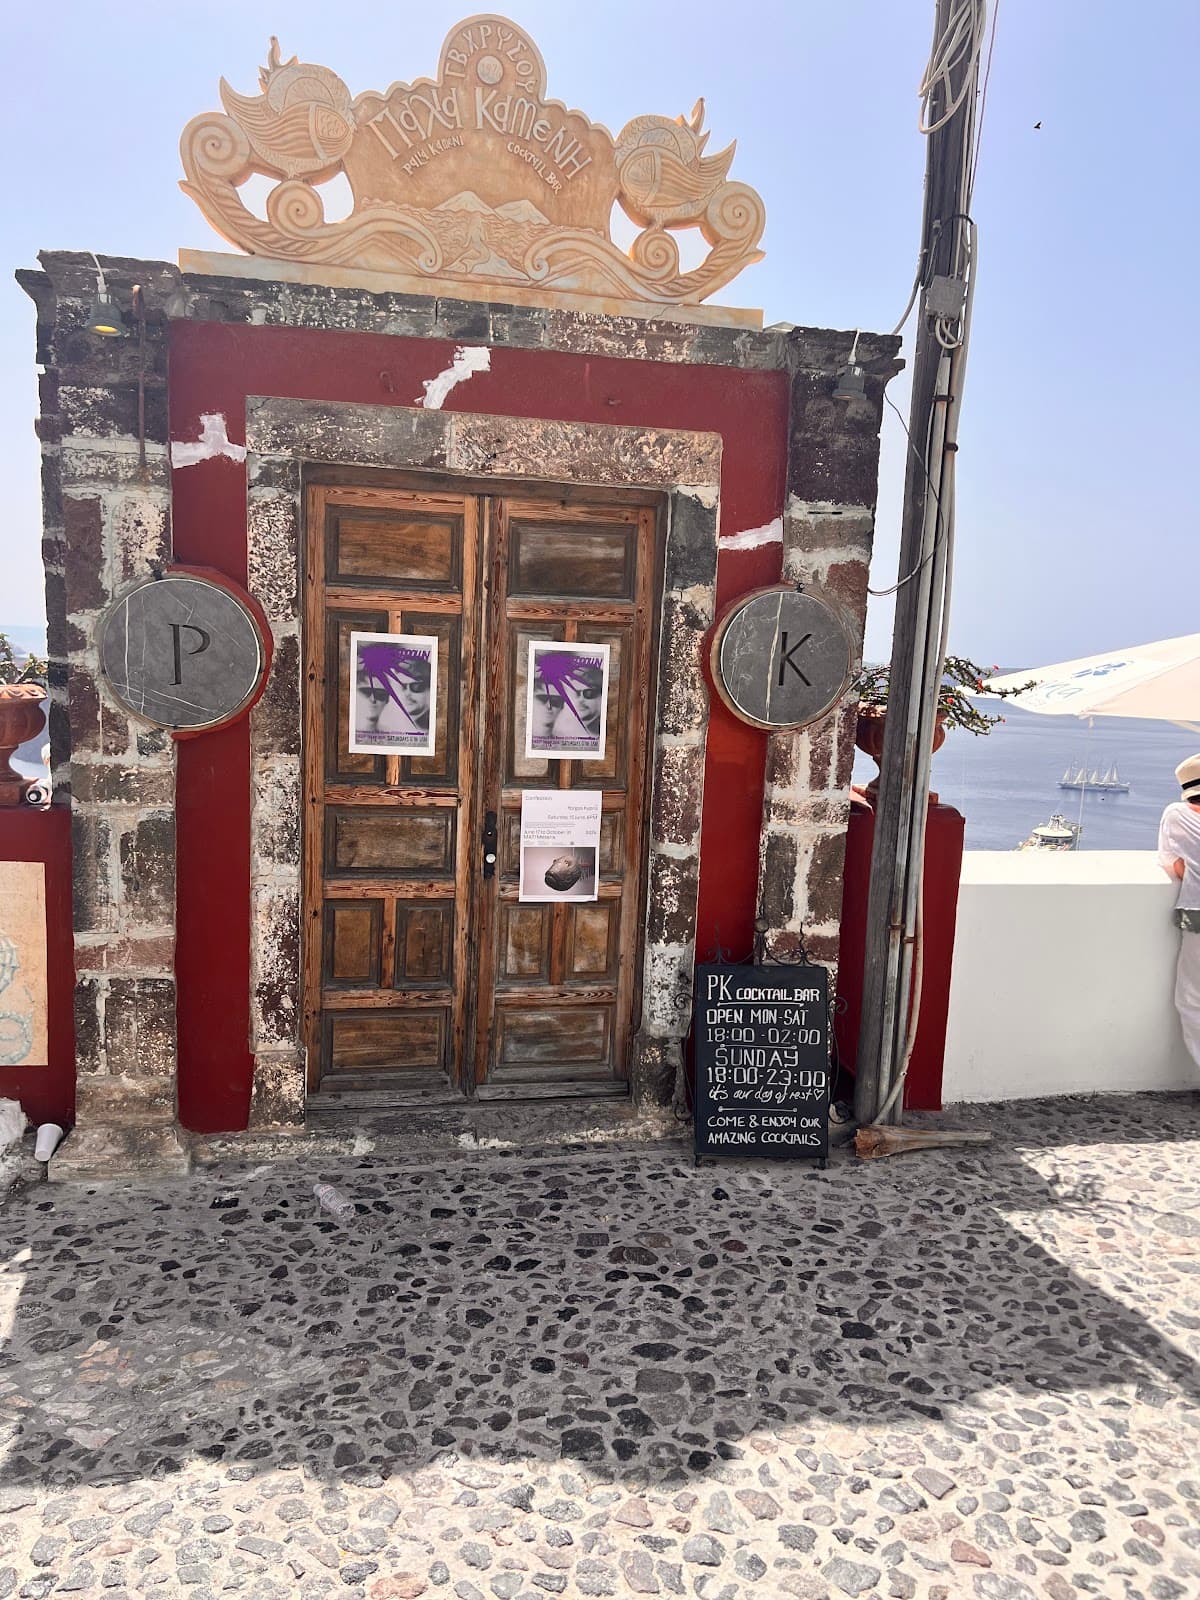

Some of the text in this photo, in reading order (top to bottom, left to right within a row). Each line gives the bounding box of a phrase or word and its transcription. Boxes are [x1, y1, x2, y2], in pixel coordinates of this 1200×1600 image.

[168, 623, 211, 686] P
[778, 631, 813, 686] K
[706, 974, 820, 1002] PK COCKTAIL BAR
[706, 1008, 808, 1026] OPEN MON-SAT
[706, 1027, 755, 1043] 18:00
[715, 1047, 799, 1068] SUNDAY
[733, 1089, 754, 1100] our
[754, 1086, 773, 1104] day
[774, 1086, 788, 1104] of
[789, 1088, 814, 1101] rest
[707, 1115, 822, 1129] COME & ENJOY OUR
[707, 1131, 822, 1146] AMAZING COCKTAILS
